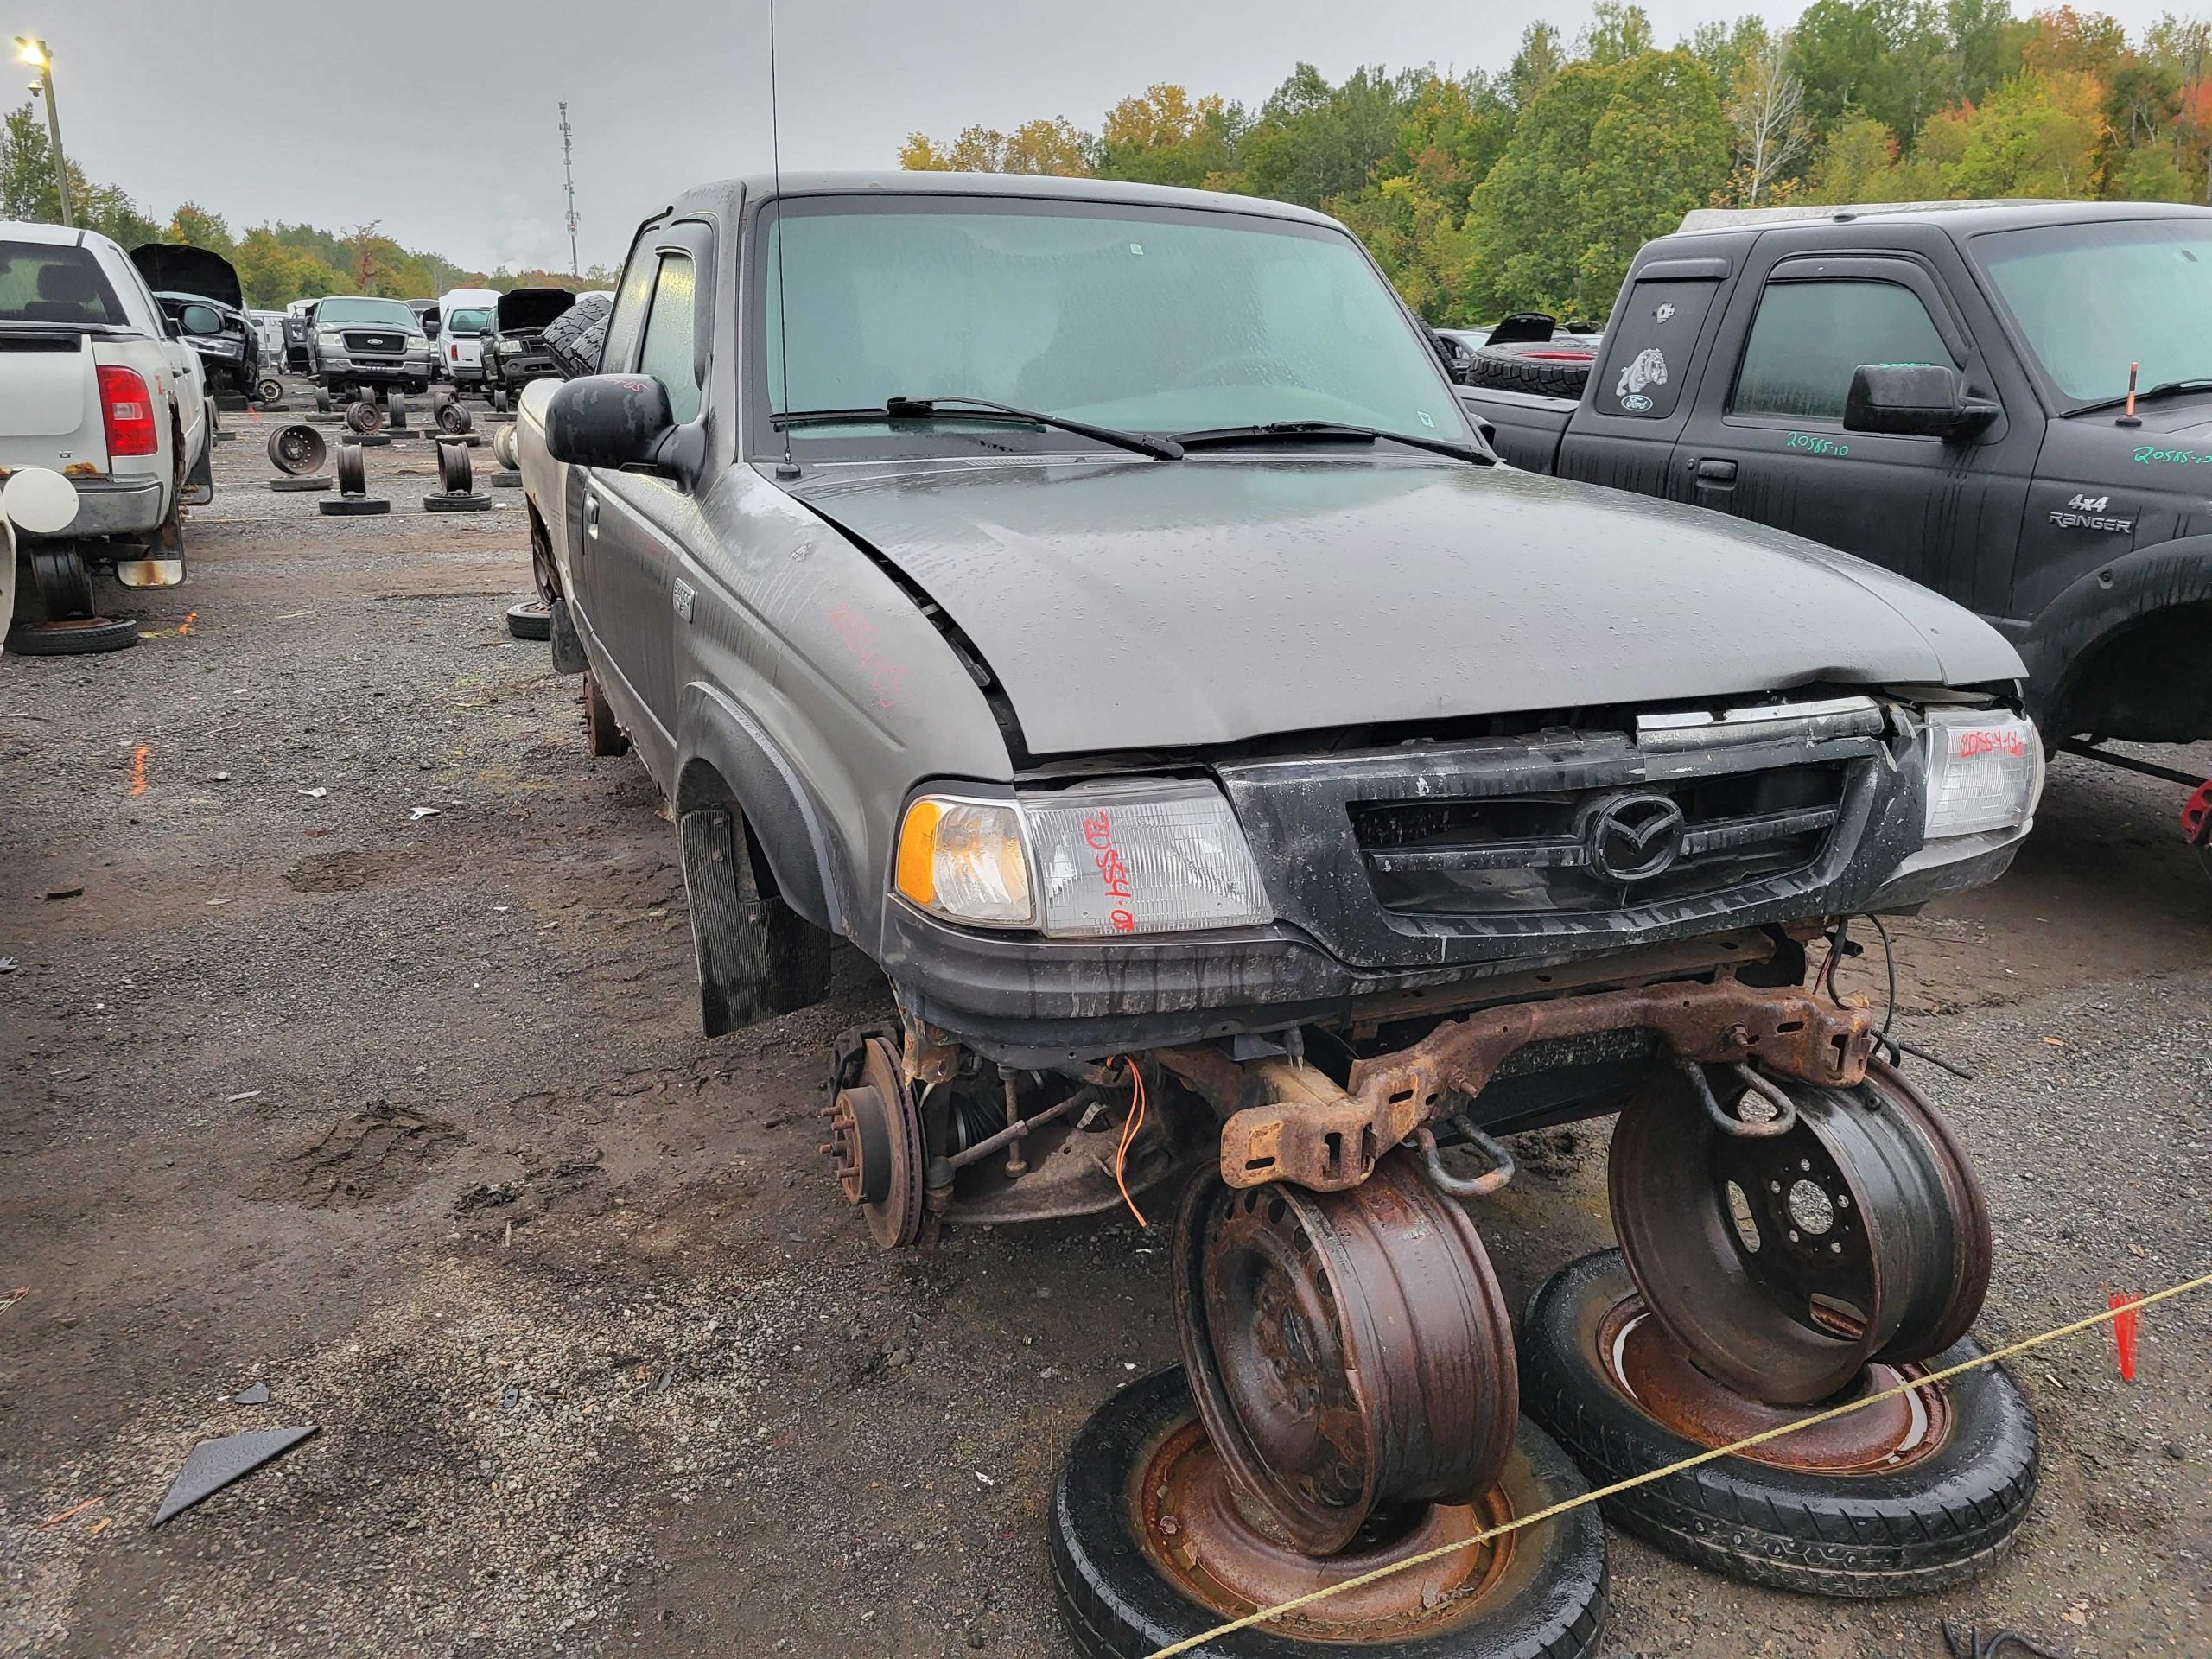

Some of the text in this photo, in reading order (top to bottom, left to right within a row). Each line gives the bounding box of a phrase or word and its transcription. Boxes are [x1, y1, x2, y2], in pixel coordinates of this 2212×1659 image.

[1625, 397, 1649, 410] Ford
[1786, 431, 1850, 456] 20585-10
[58, 450, 73, 459] LT
[2068, 493, 2109, 512] 4x4
[2048, 512, 2133, 534] RANGER
